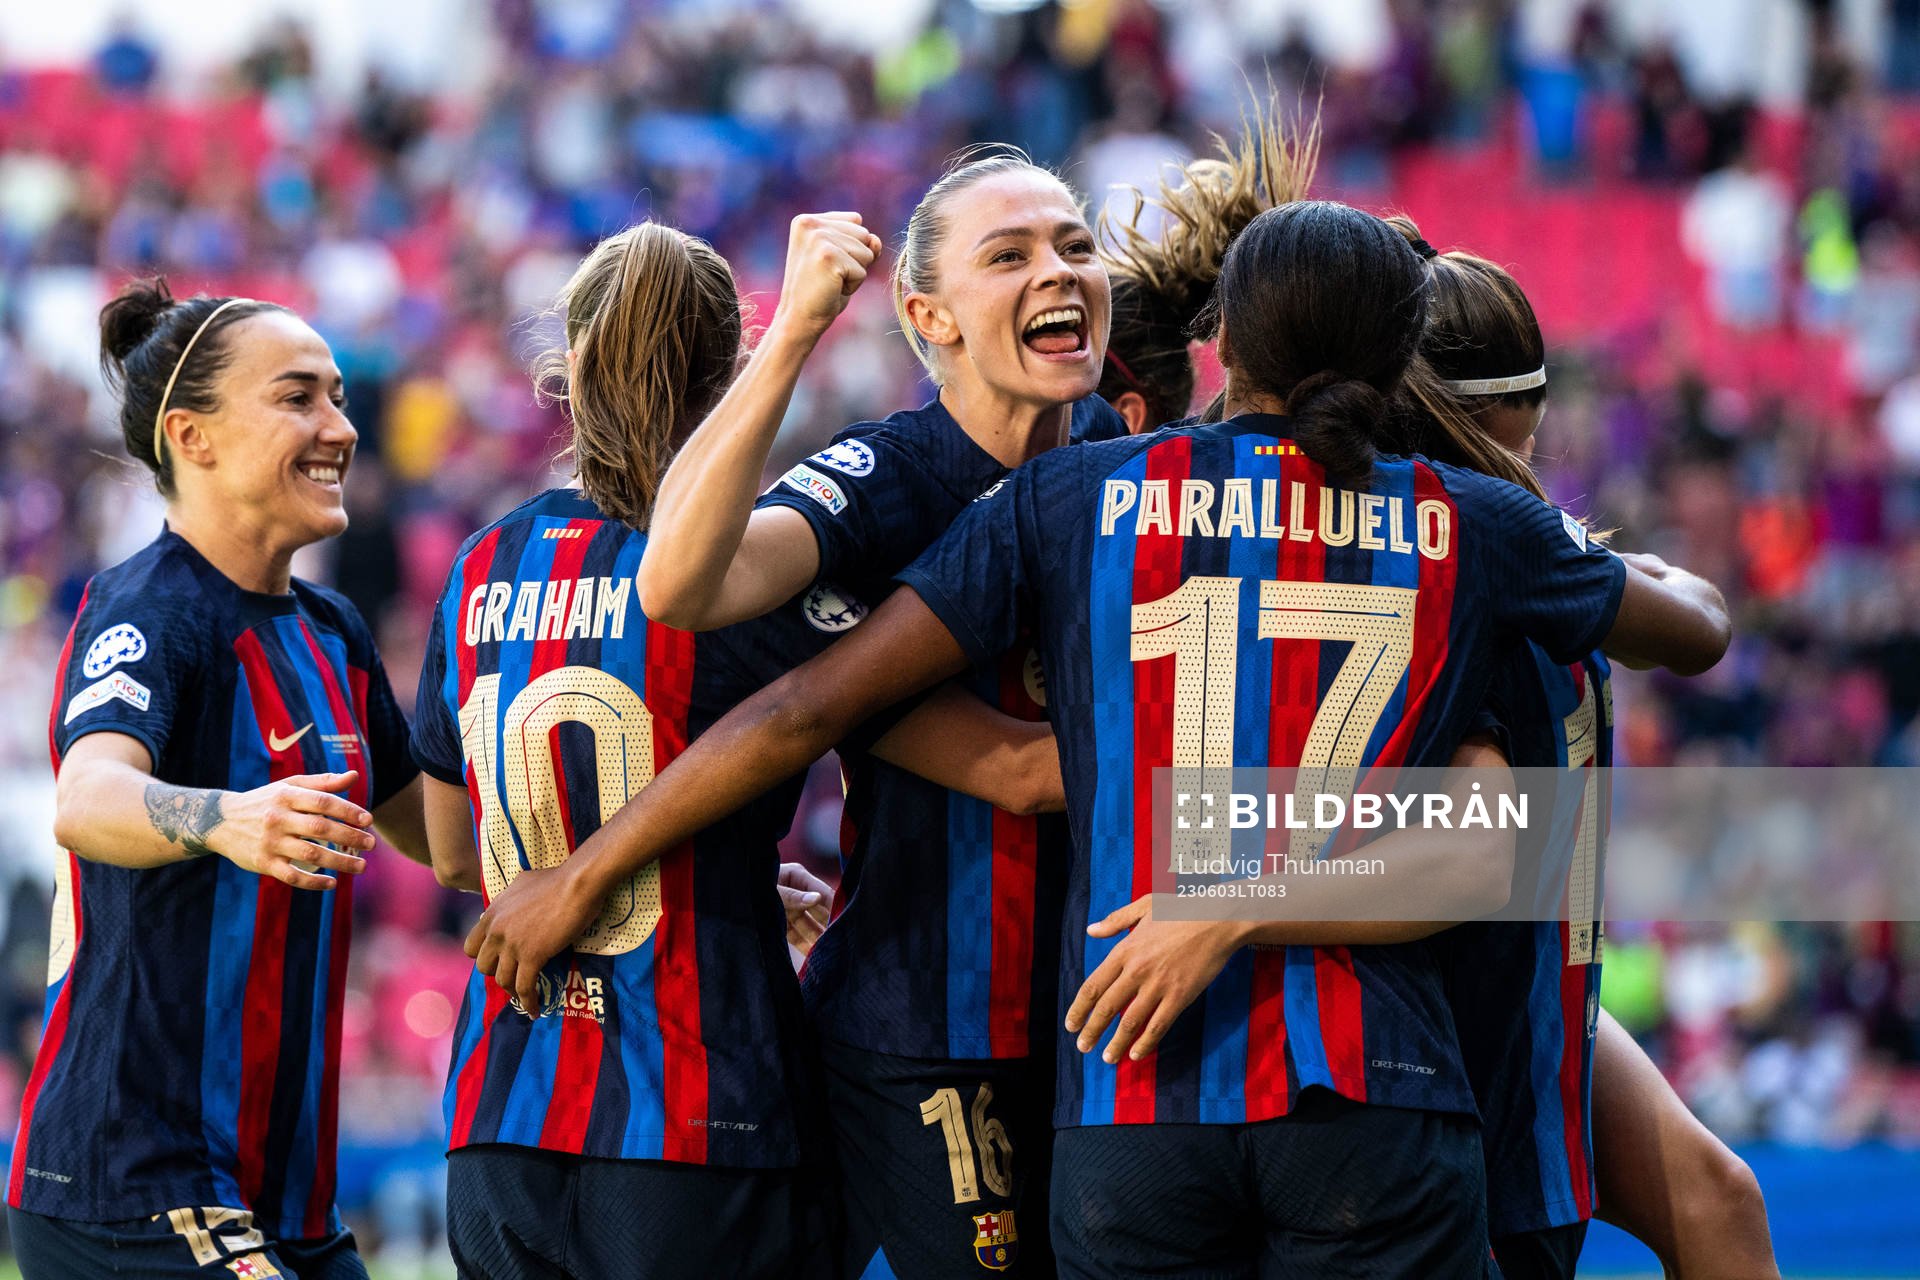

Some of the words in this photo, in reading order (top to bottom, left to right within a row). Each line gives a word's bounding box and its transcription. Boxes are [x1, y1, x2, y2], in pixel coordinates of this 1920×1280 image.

[1101, 478, 1451, 561] PARALLUELO
[465, 576, 632, 647] GRAHAM
[1130, 575, 1419, 873] 17
[457, 665, 663, 956] 10
[919, 1081, 1013, 1204] 16
